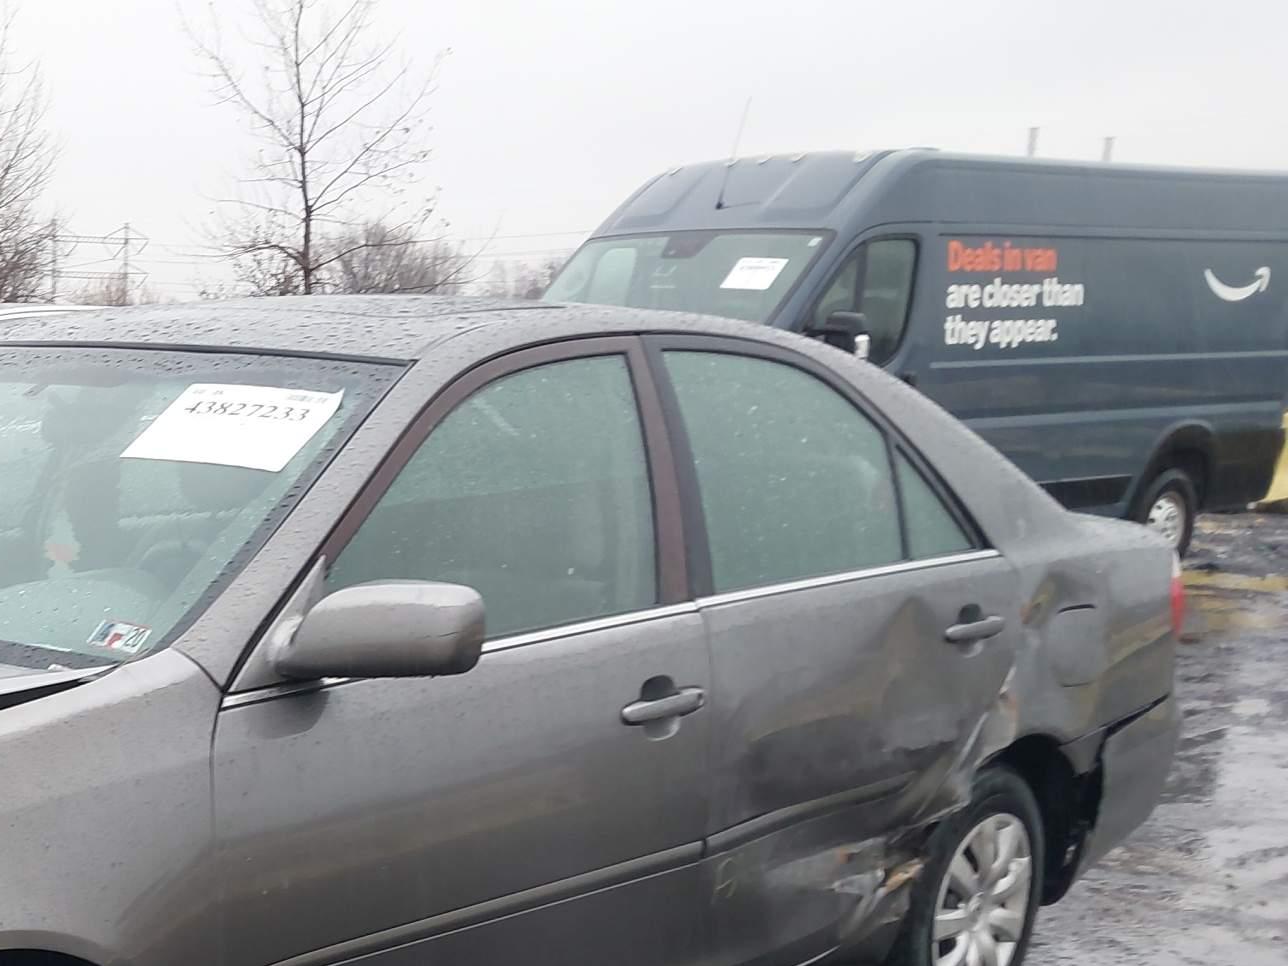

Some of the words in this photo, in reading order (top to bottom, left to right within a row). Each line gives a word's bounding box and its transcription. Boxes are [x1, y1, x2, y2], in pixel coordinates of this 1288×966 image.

[948, 240, 1002, 271] Deals
[1002, 241, 1021, 271] in
[1024, 249, 1058, 271] van
[946, 284, 981, 308] are
[982, 277, 1042, 308] closer
[1042, 277, 1084, 307] than
[944, 314, 990, 350] they
[989, 319, 1058, 348] appear.
[184, 400, 311, 421] 43827233
